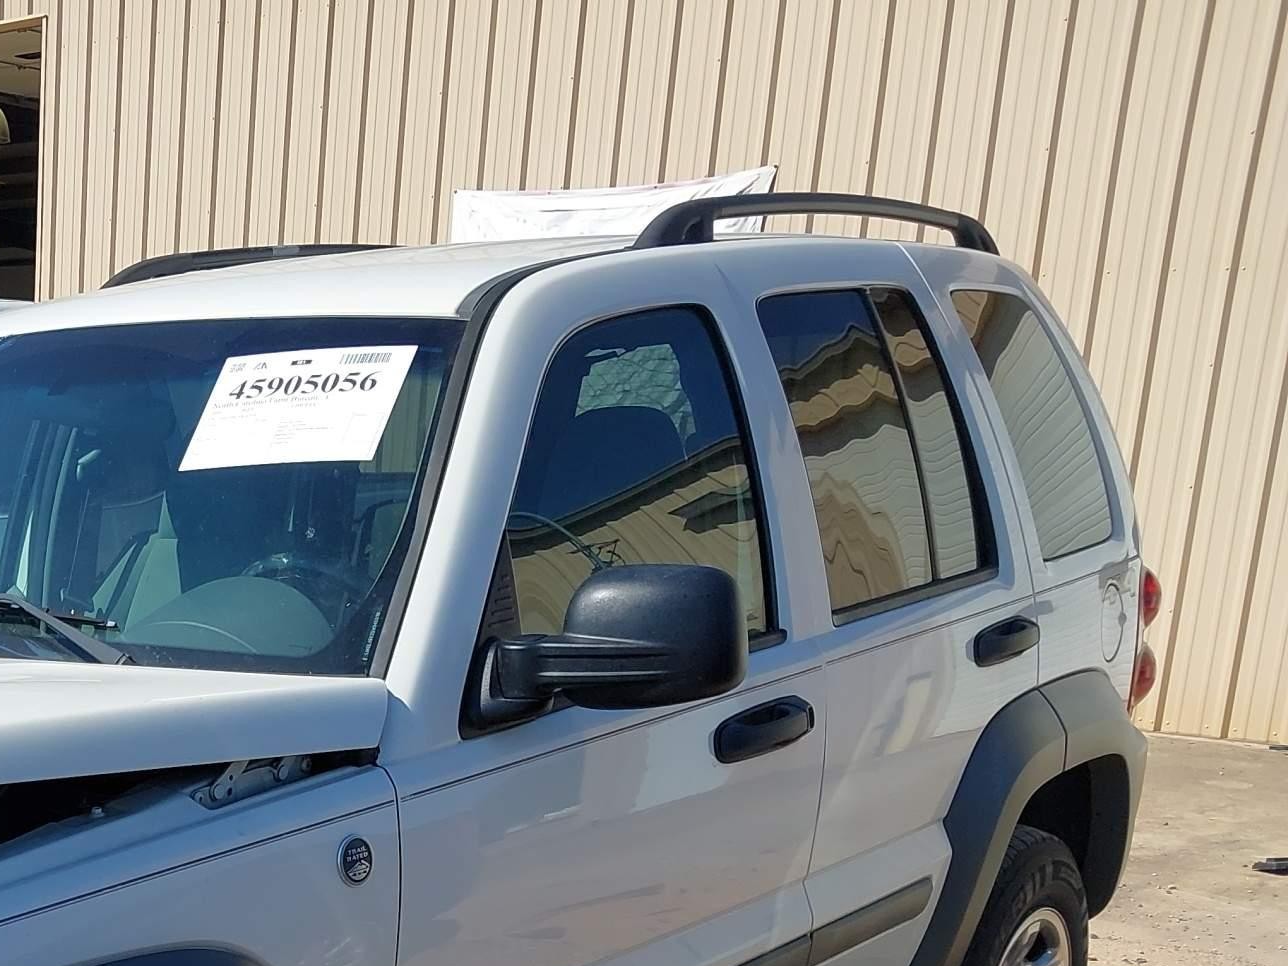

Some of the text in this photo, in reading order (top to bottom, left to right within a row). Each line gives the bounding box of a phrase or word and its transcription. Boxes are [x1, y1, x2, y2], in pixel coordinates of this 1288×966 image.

[228, 371, 383, 400] 45905056
[347, 845, 367, 856] TRAIL
[346, 851, 368, 863] RATED
